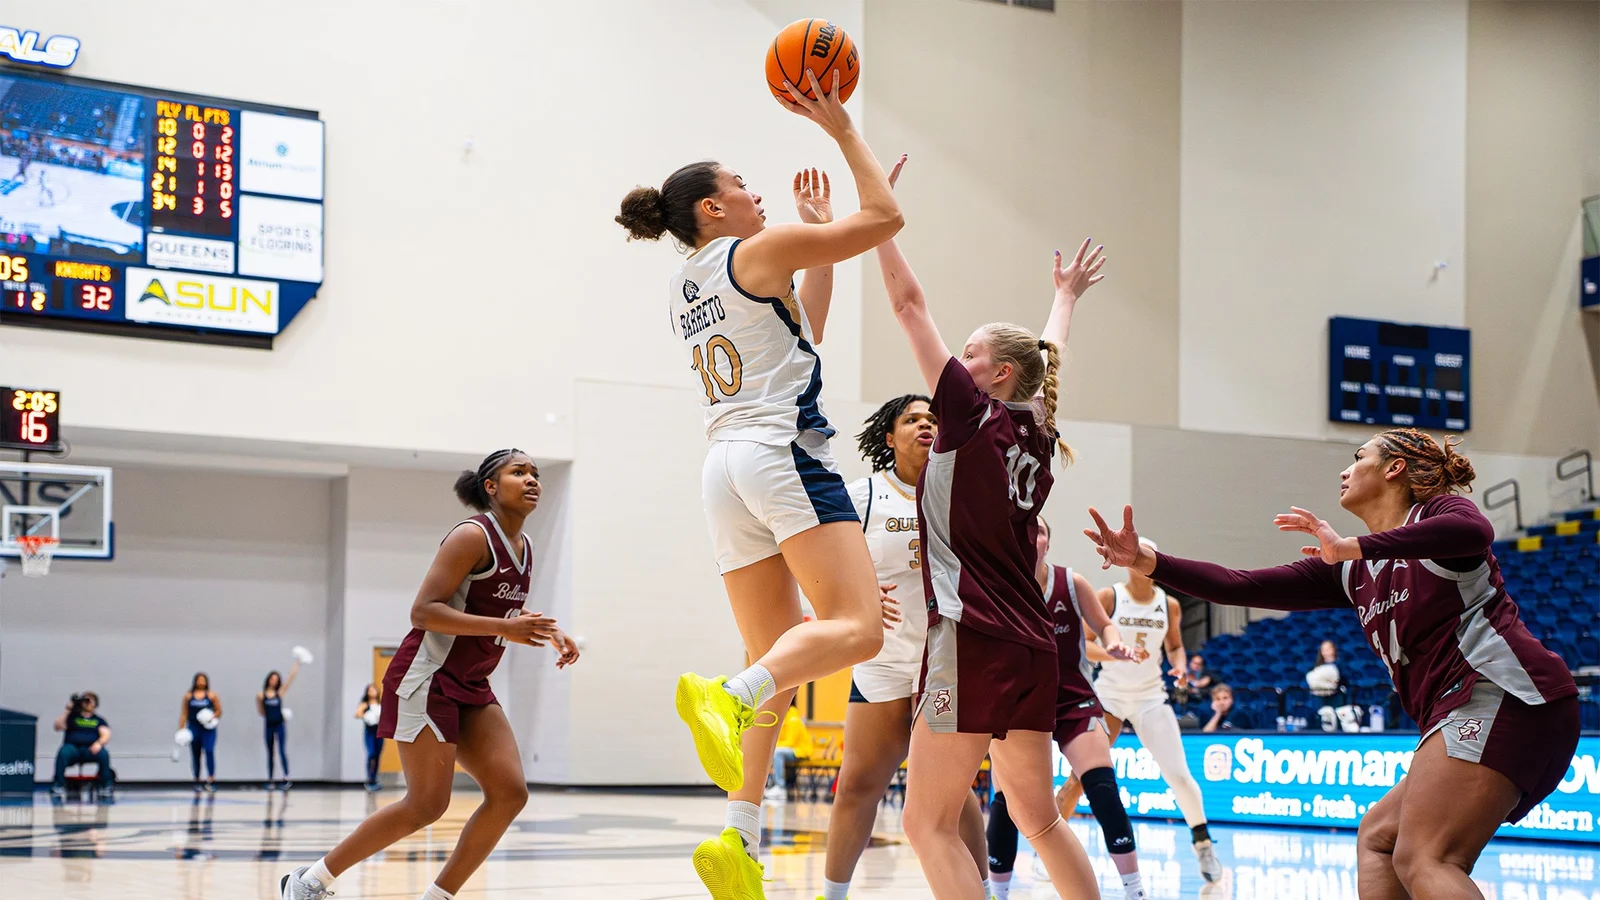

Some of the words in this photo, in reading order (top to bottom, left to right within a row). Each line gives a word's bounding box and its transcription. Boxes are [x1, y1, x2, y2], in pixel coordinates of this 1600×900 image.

[185, 104, 203, 122] FL
[203, 107, 231, 125] PTS
[158, 118, 177, 137] 10
[192, 122, 205, 140] 0
[221, 126, 233, 144] 2
[157, 136, 177, 156] 12
[192, 140, 205, 159] 0
[215, 144, 233, 163] 12
[157, 155, 177, 173] 14
[198, 161, 205, 176] 1
[214, 163, 233, 181] 13
[151, 172, 177, 191] 21
[197, 179, 204, 195] 1
[220, 181, 233, 200] 0
[152, 191, 177, 211] 34
[192, 196, 204, 215] 3
[219, 200, 232, 218] 5
[149, 239, 229, 261] QUEENS
[55, 260, 112, 282] KNIGHTS
[82, 284, 113, 311] 32
[679, 294, 726, 340] BARRETO
[691, 334, 743, 406] 10
[12, 389, 57, 414] 2:05
[21, 411, 48, 443] 16
[1006, 443, 1041, 511] 10
[1119, 616, 1165, 631] QUEENS
[1232, 791, 1302, 817] southern
[1312, 794, 1357, 820] fresh
[1501, 802, 1594, 832] uthern
